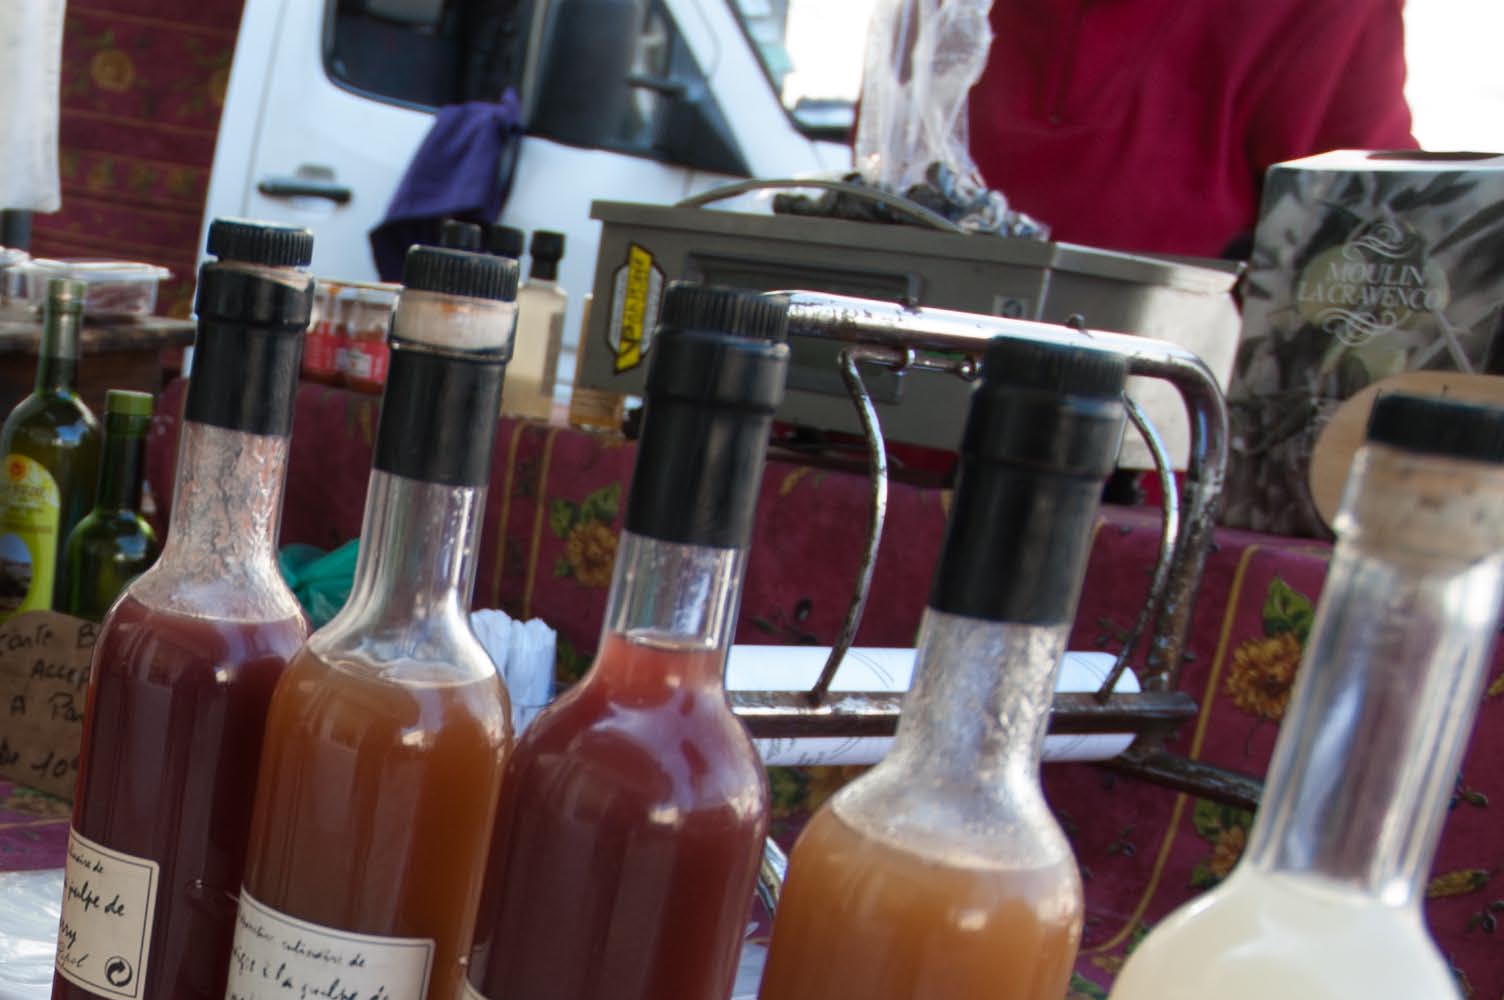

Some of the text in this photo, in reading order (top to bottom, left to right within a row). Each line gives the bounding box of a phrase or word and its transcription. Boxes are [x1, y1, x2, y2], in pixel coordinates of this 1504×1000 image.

[1327, 262, 1424, 287] MOULIN
[77, 622, 96, 650] B
[31, 658, 90, 691] Accep
[10, 691, 84, 721] A Pa
[104, 893, 126, 917] de
[348, 951, 366, 968] de
[275, 961, 294, 990] la
